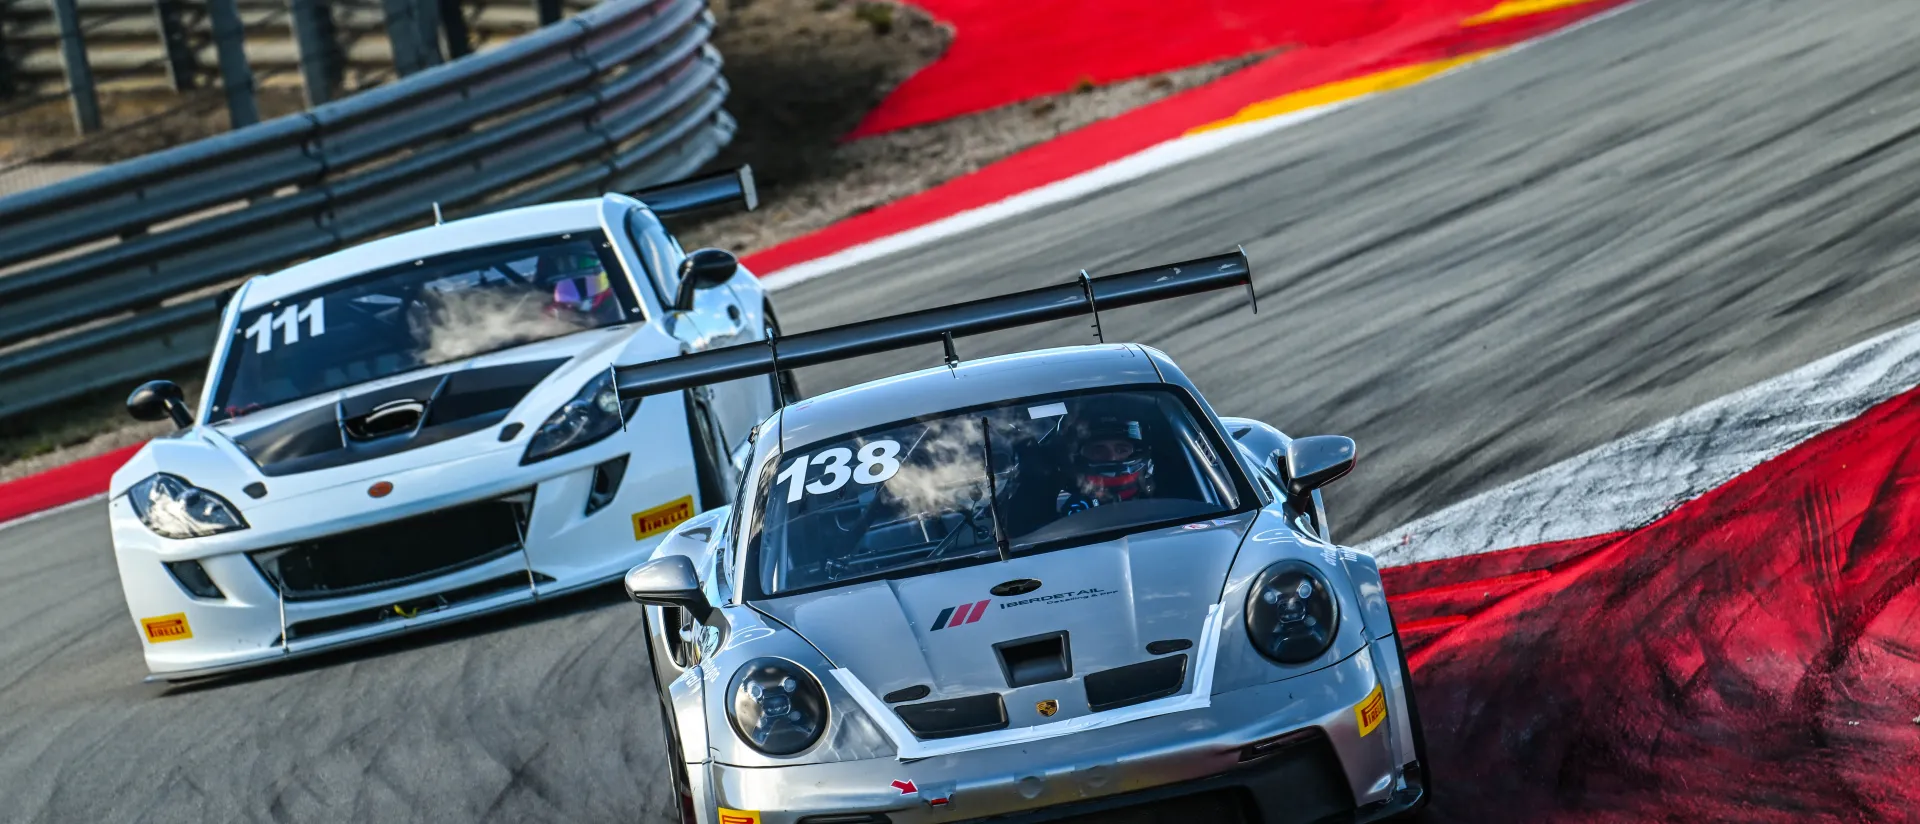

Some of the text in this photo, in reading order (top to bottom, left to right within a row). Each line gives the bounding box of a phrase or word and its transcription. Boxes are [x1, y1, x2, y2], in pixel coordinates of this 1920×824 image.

[245, 296, 325, 353] 111
[777, 440, 900, 503] 138
[638, 502, 689, 533] PIRELLI
[1000, 588, 1104, 609] IBERDETAIL
[147, 619, 185, 638] PIRELLI
[1361, 691, 1385, 728] PIRELLI
